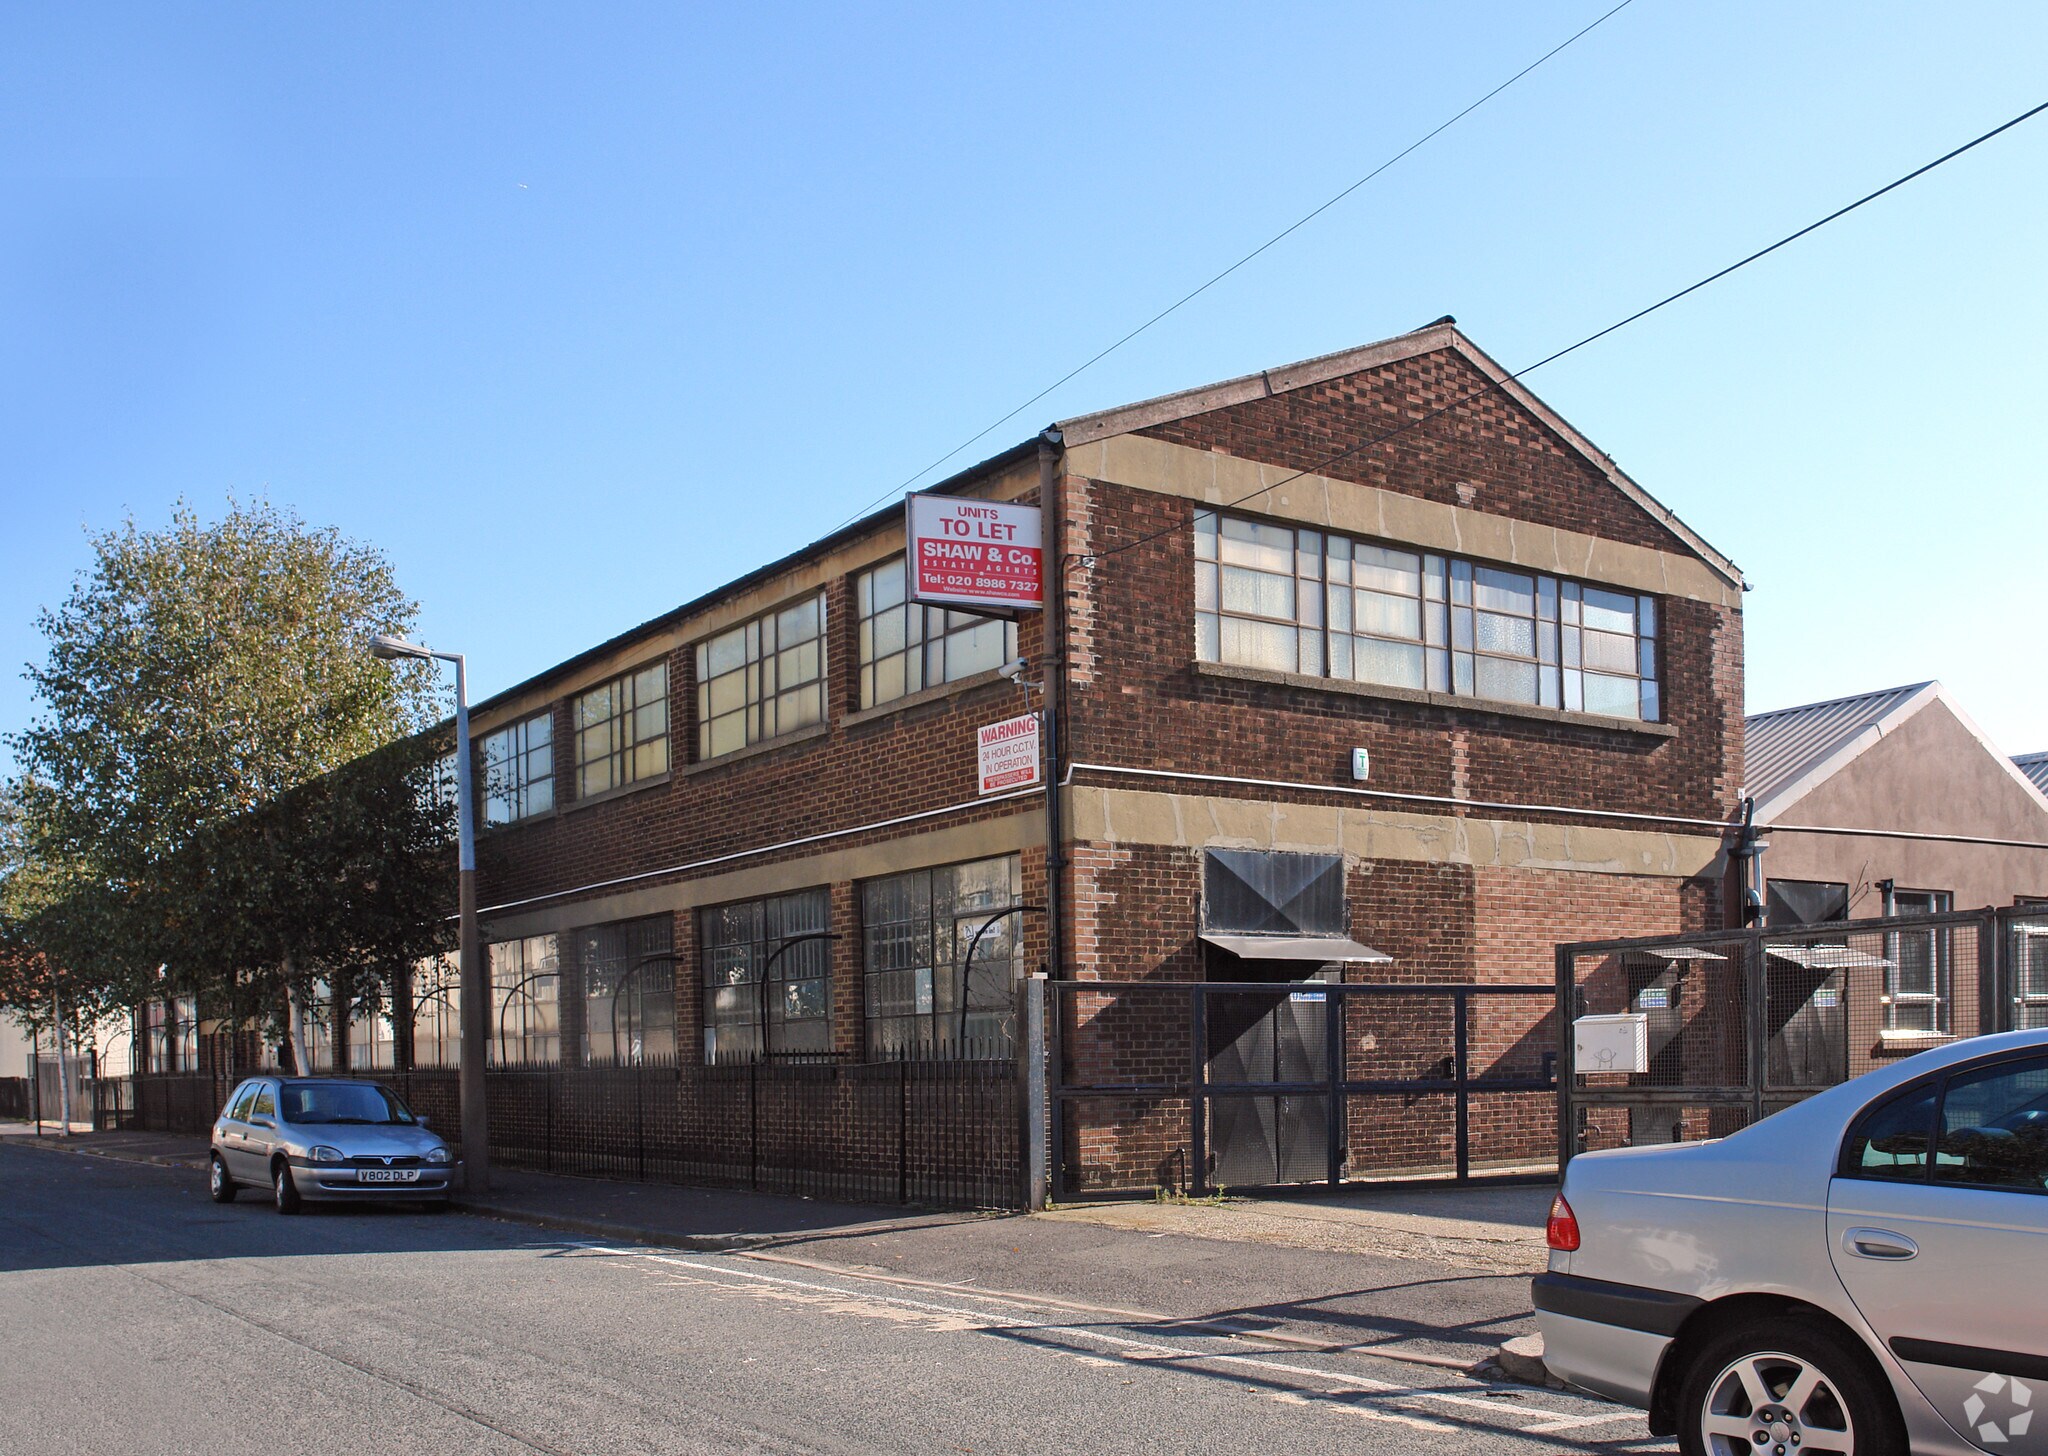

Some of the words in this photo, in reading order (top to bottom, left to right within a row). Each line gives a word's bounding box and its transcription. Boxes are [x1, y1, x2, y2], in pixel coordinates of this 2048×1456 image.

[957, 506, 999, 520] UNITS
[939, 518, 970, 536] TO
[978, 521, 1017, 541] LET
[923, 542, 982, 561] SHAW
[987, 547, 1003, 562] &
[1008, 549, 1037, 566] Co.
[924, 559, 975, 570] ESTATE
[986, 565, 1037, 576] AGENTS
[923, 573, 945, 584] Tel:
[947, 575, 972, 586] 020
[975, 577, 1006, 589] 8986
[1009, 580, 1039, 592] 7327
[981, 717, 1035, 744] WARNING
[982, 752, 990, 761] 24
[991, 746, 1011, 759] HOUR
[985, 764, 993, 774] IN
[994, 754, 1033, 772] OPERATION
[361, 1171, 390, 1181] V802
[393, 1171, 414, 1181] DLP
